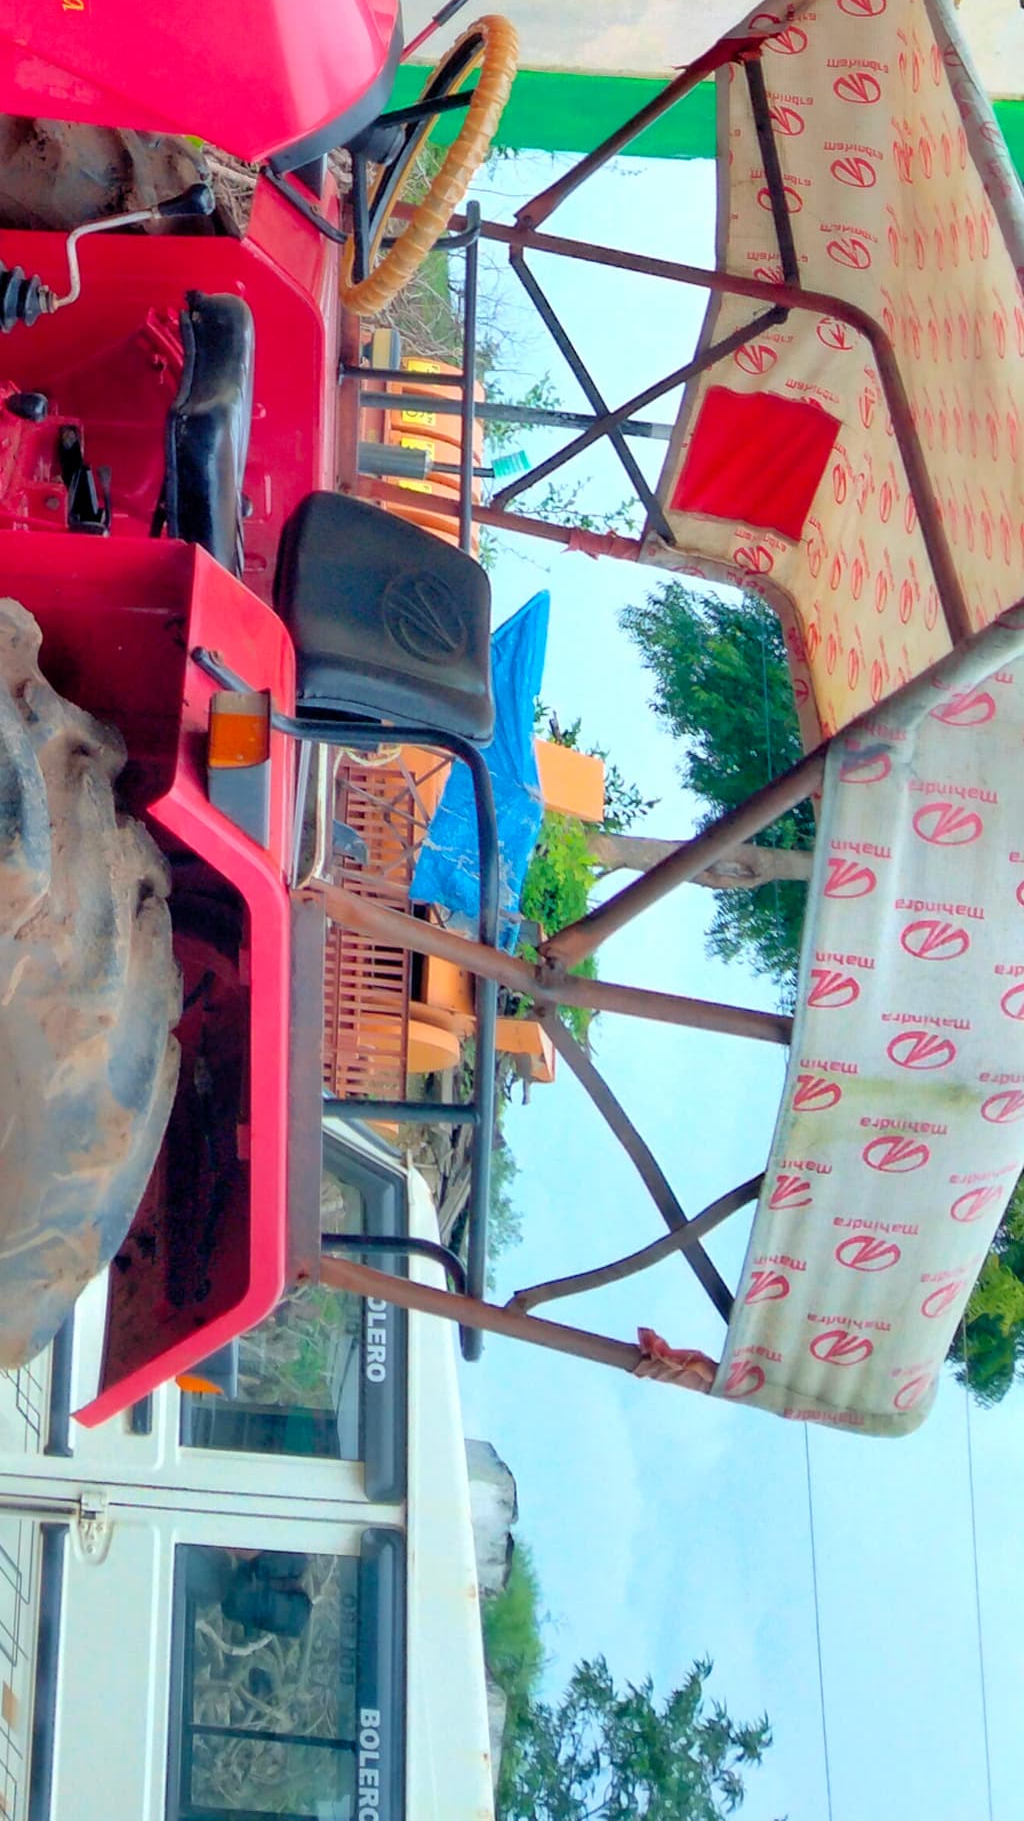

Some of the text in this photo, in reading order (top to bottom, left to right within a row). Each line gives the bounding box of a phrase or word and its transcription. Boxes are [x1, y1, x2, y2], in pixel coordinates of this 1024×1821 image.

[894, 898, 985, 920] mahindra
[880, 1011, 971, 1031] mahindra
[366, 1296, 387, 1383] OLERO
